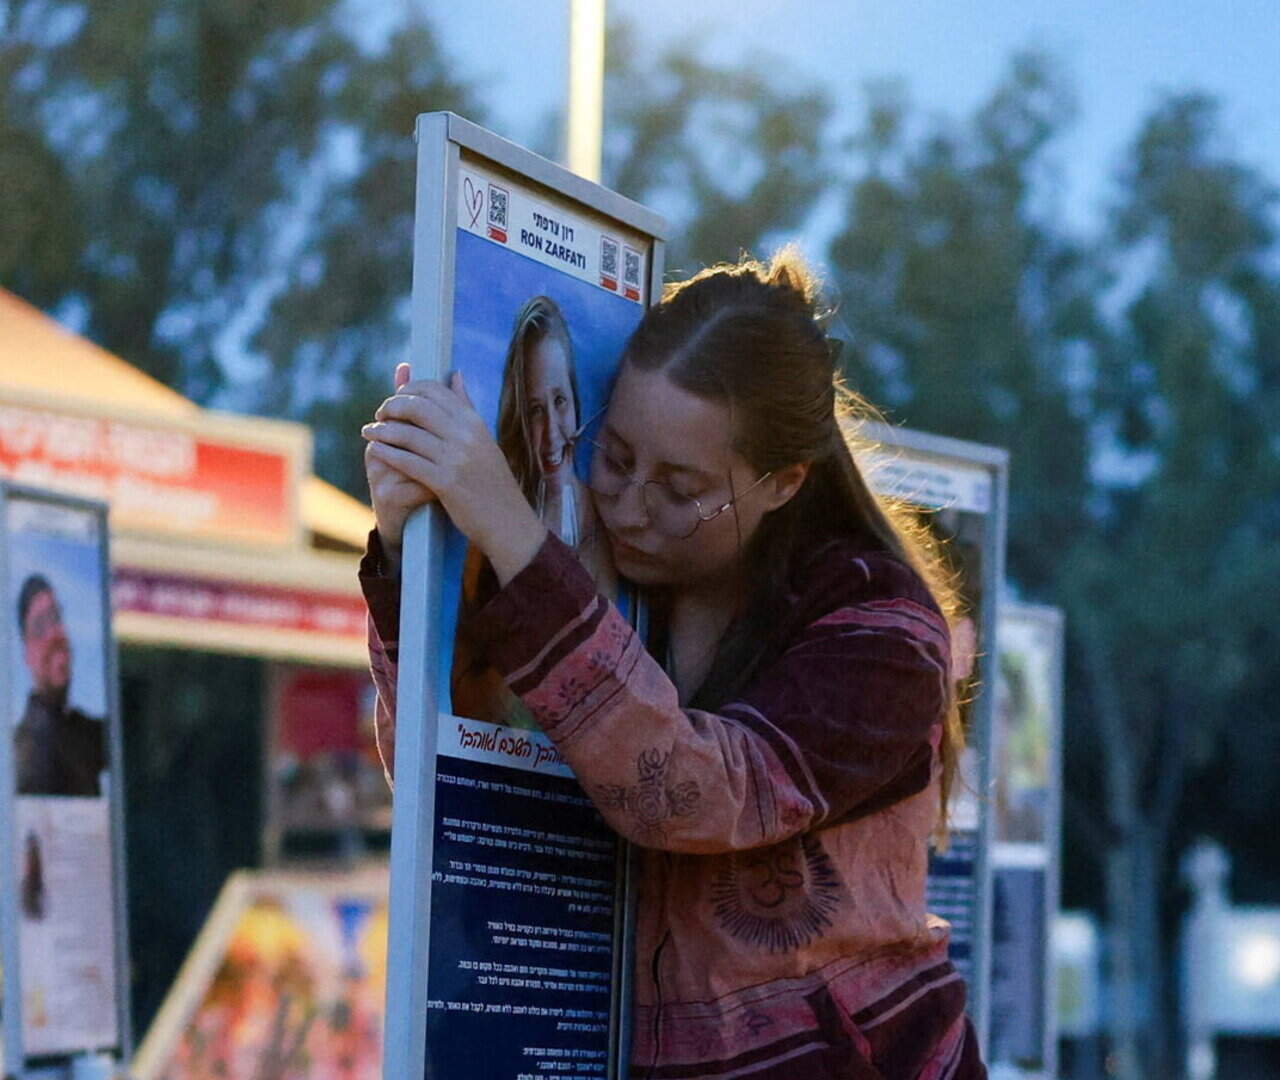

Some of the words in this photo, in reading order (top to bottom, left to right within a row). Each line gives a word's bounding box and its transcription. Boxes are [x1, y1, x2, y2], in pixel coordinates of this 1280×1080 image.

[532, 212, 560, 236] צרפתי
[562, 225, 574, 243] רון
[521, 229, 543, 251] RON
[545, 240, 586, 270] ZARFATI
